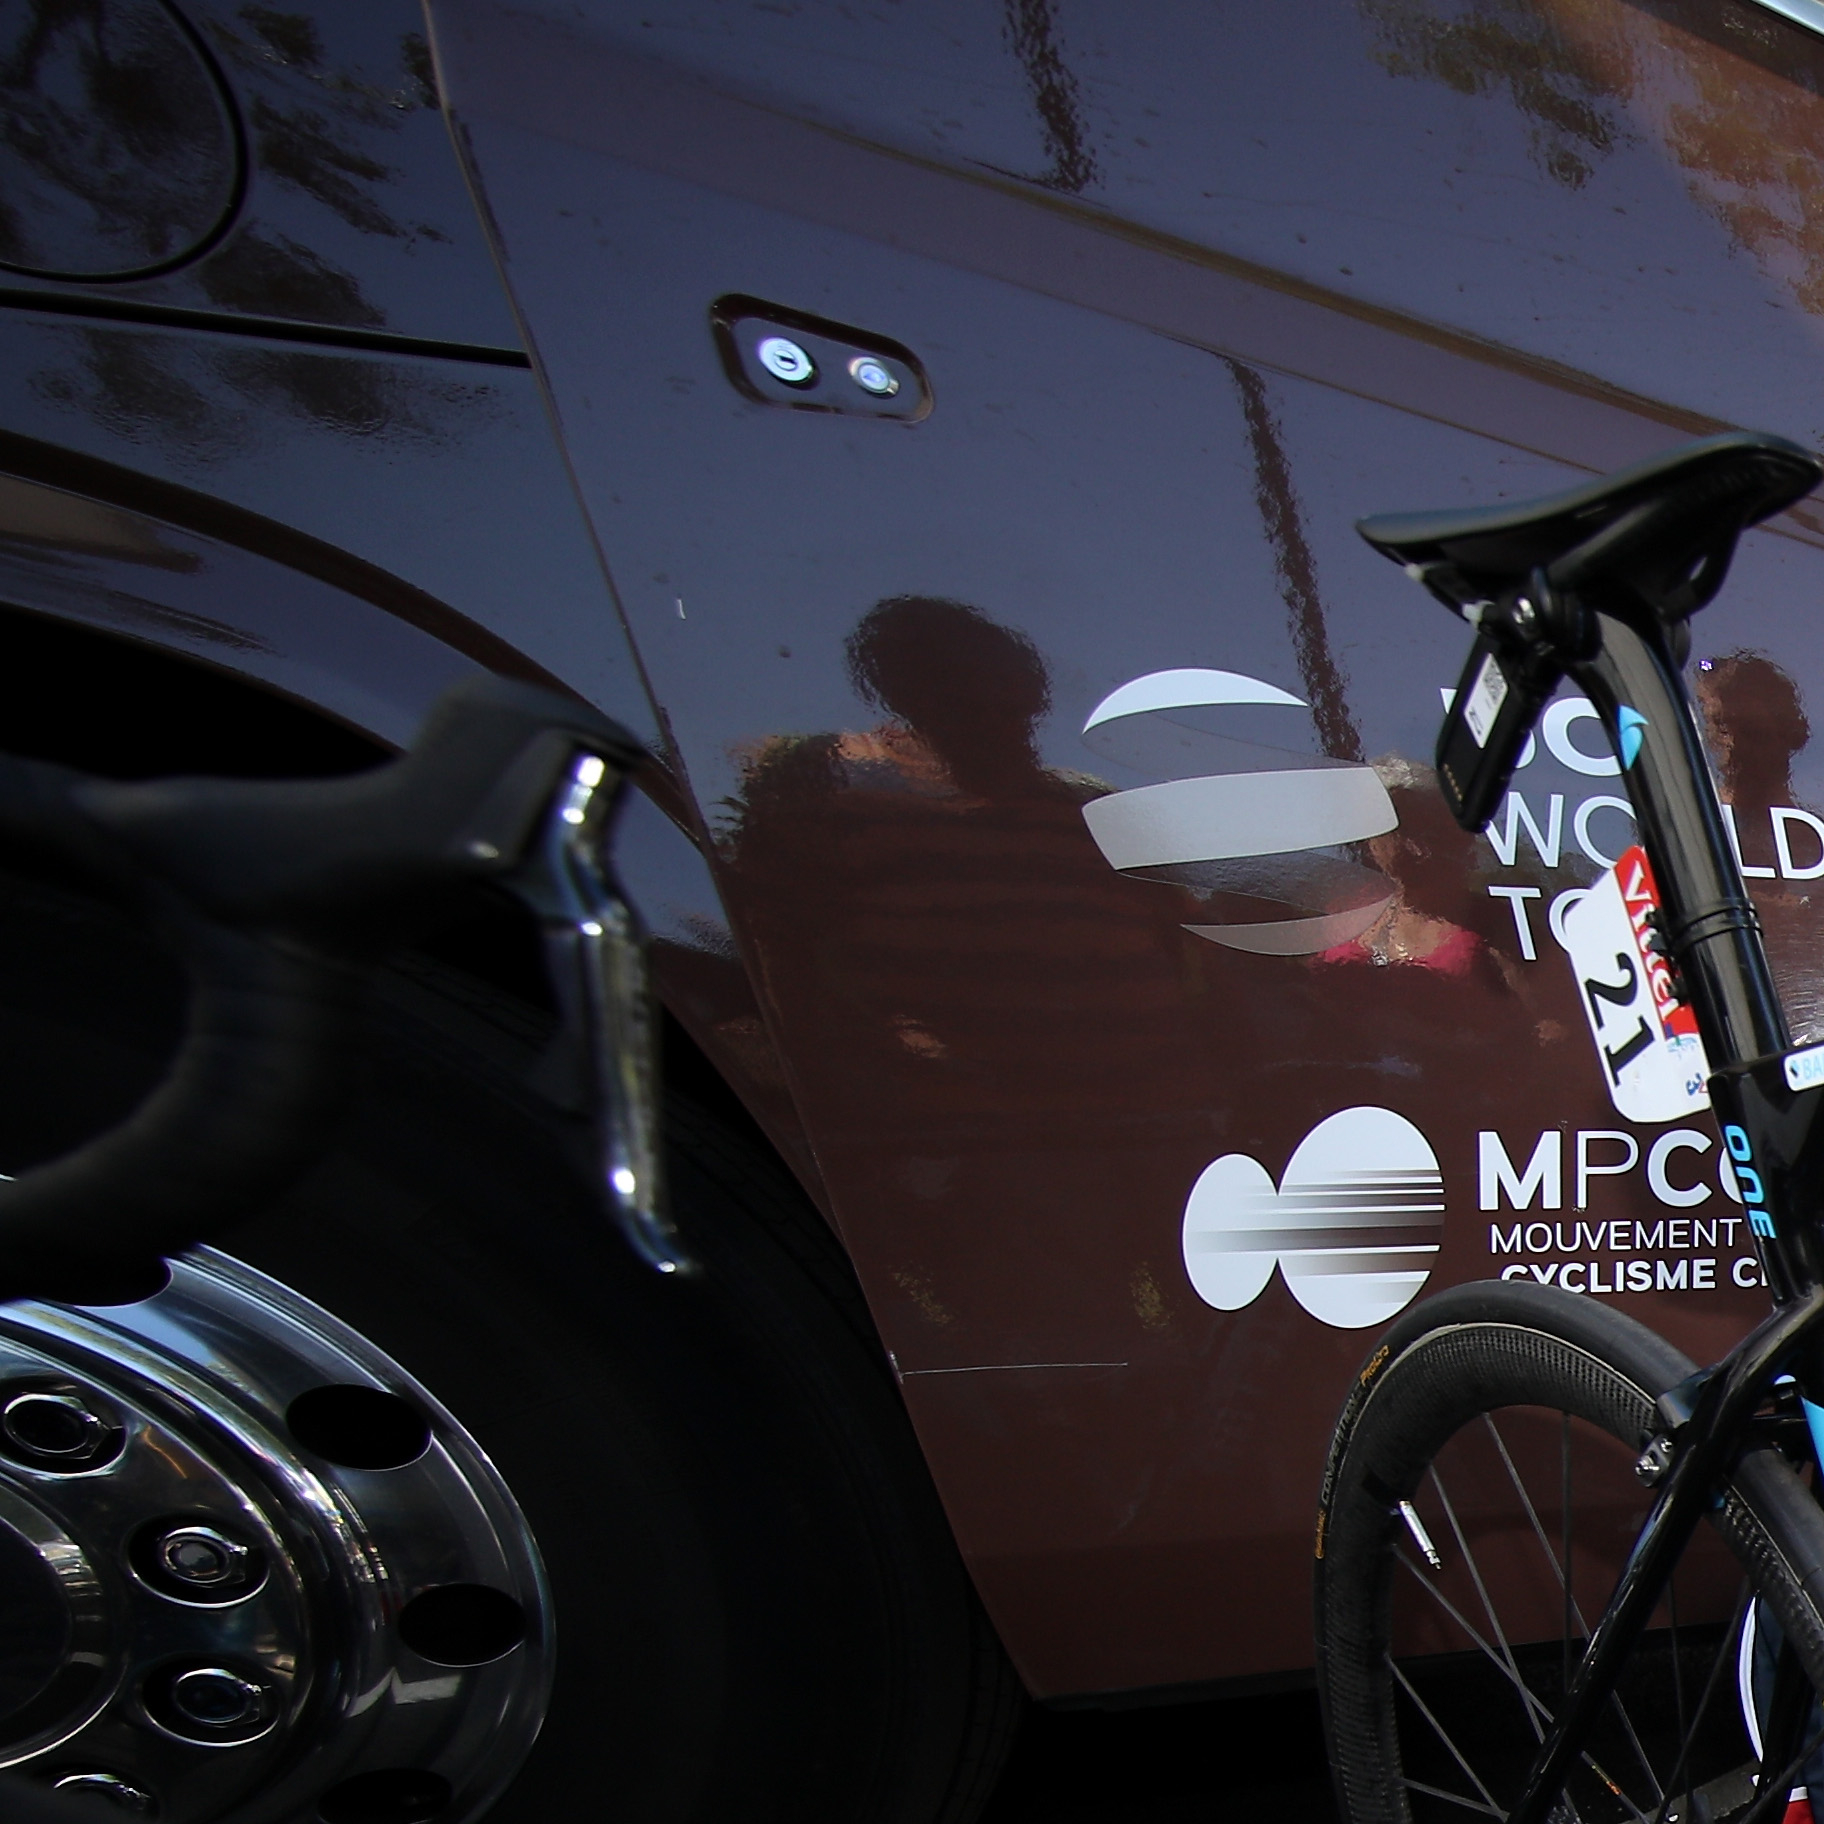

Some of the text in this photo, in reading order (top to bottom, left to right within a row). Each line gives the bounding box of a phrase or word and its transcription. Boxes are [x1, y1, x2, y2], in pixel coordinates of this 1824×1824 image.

[1585, 953, 1657, 1088] 21
[1491, 1218, 1743, 1254] MOUVEMENT
[1501, 1259, 1716, 1295] CYCLISME
